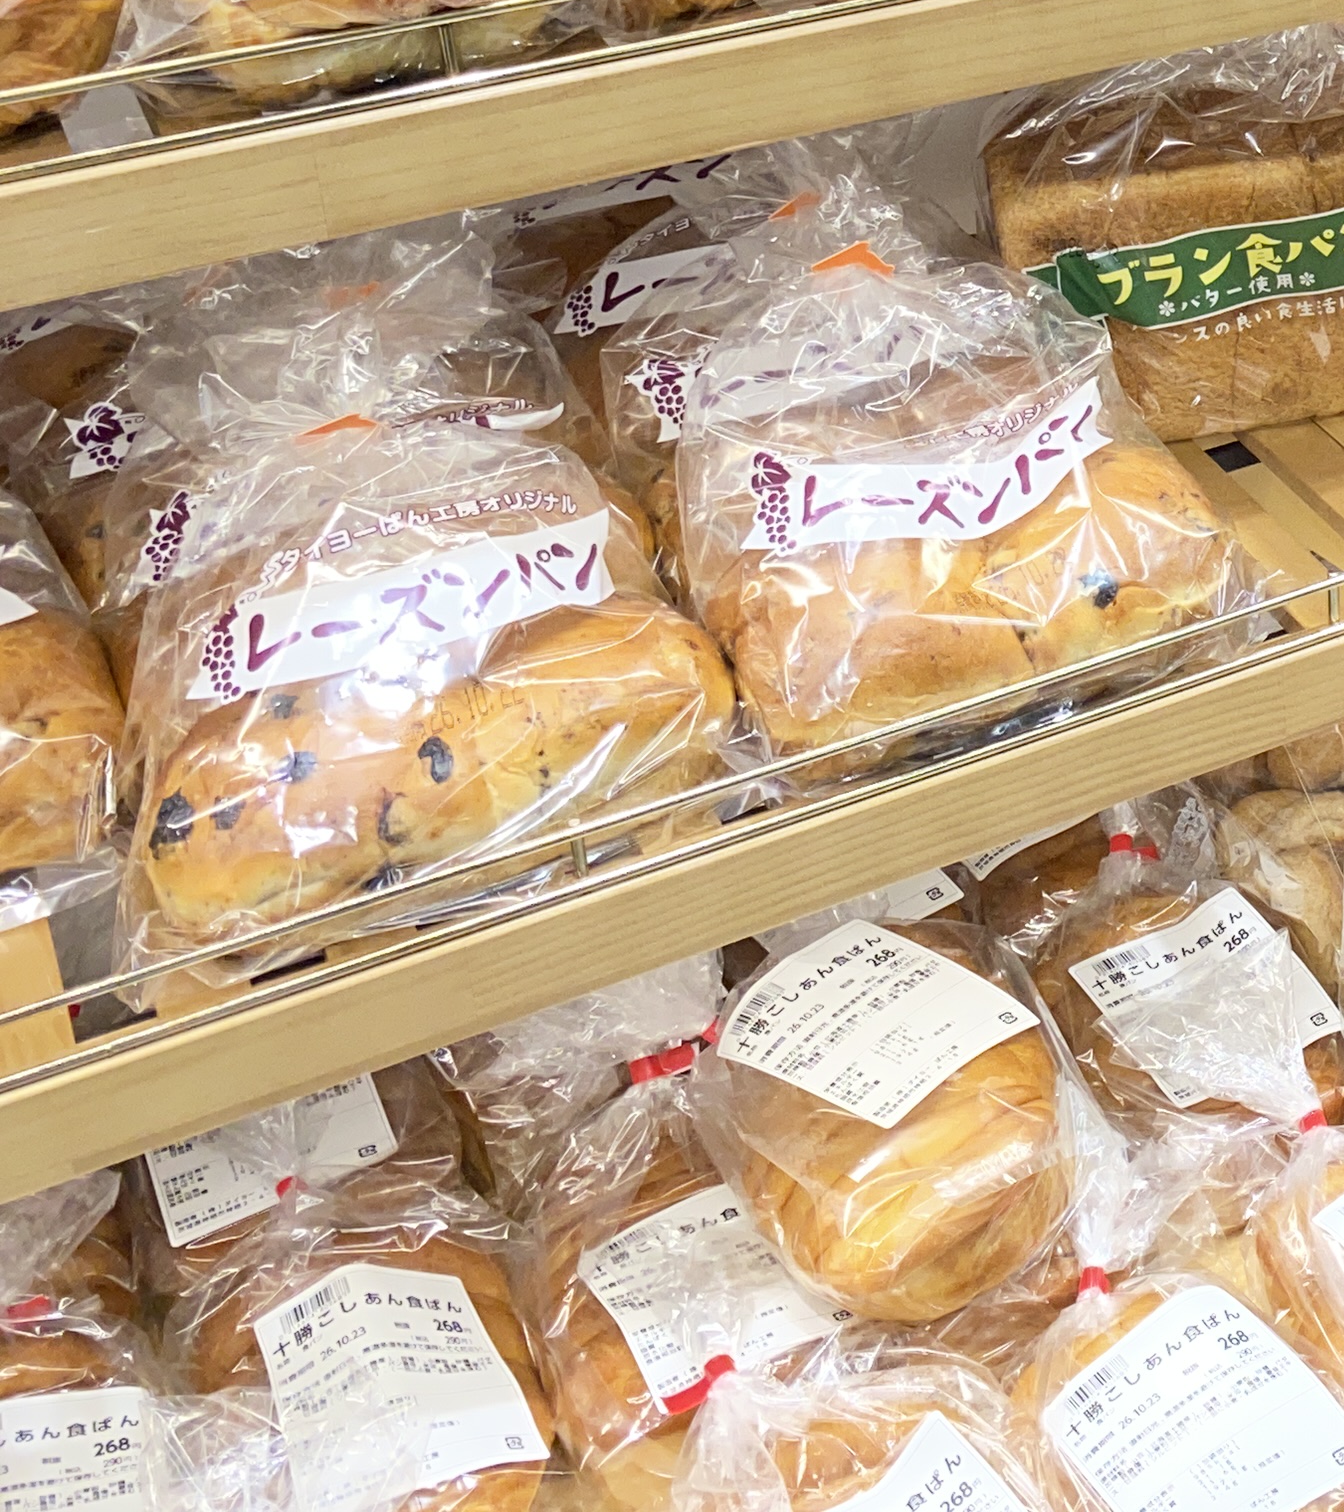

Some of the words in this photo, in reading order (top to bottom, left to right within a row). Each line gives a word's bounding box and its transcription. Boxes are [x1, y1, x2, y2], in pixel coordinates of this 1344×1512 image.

[1180, 272, 1296, 314] バター使用
[798, 404, 1093, 529] レーズンパン
[246, 540, 600, 673] レーズンパン
[1092, 910, 1243, 992] 十勝こしあん食ぱん
[729, 935, 882, 1055] 十勝こしあん食ぱん
[273, 1291, 463, 1358] 十勝こしあん食ぱん
[320, 1326, 368, 1361] 26.10.23
[1066, 1309, 1240, 1437] 十勝こしあん食ぱん
[1118, 1392, 1161, 1430] 26.10.23
